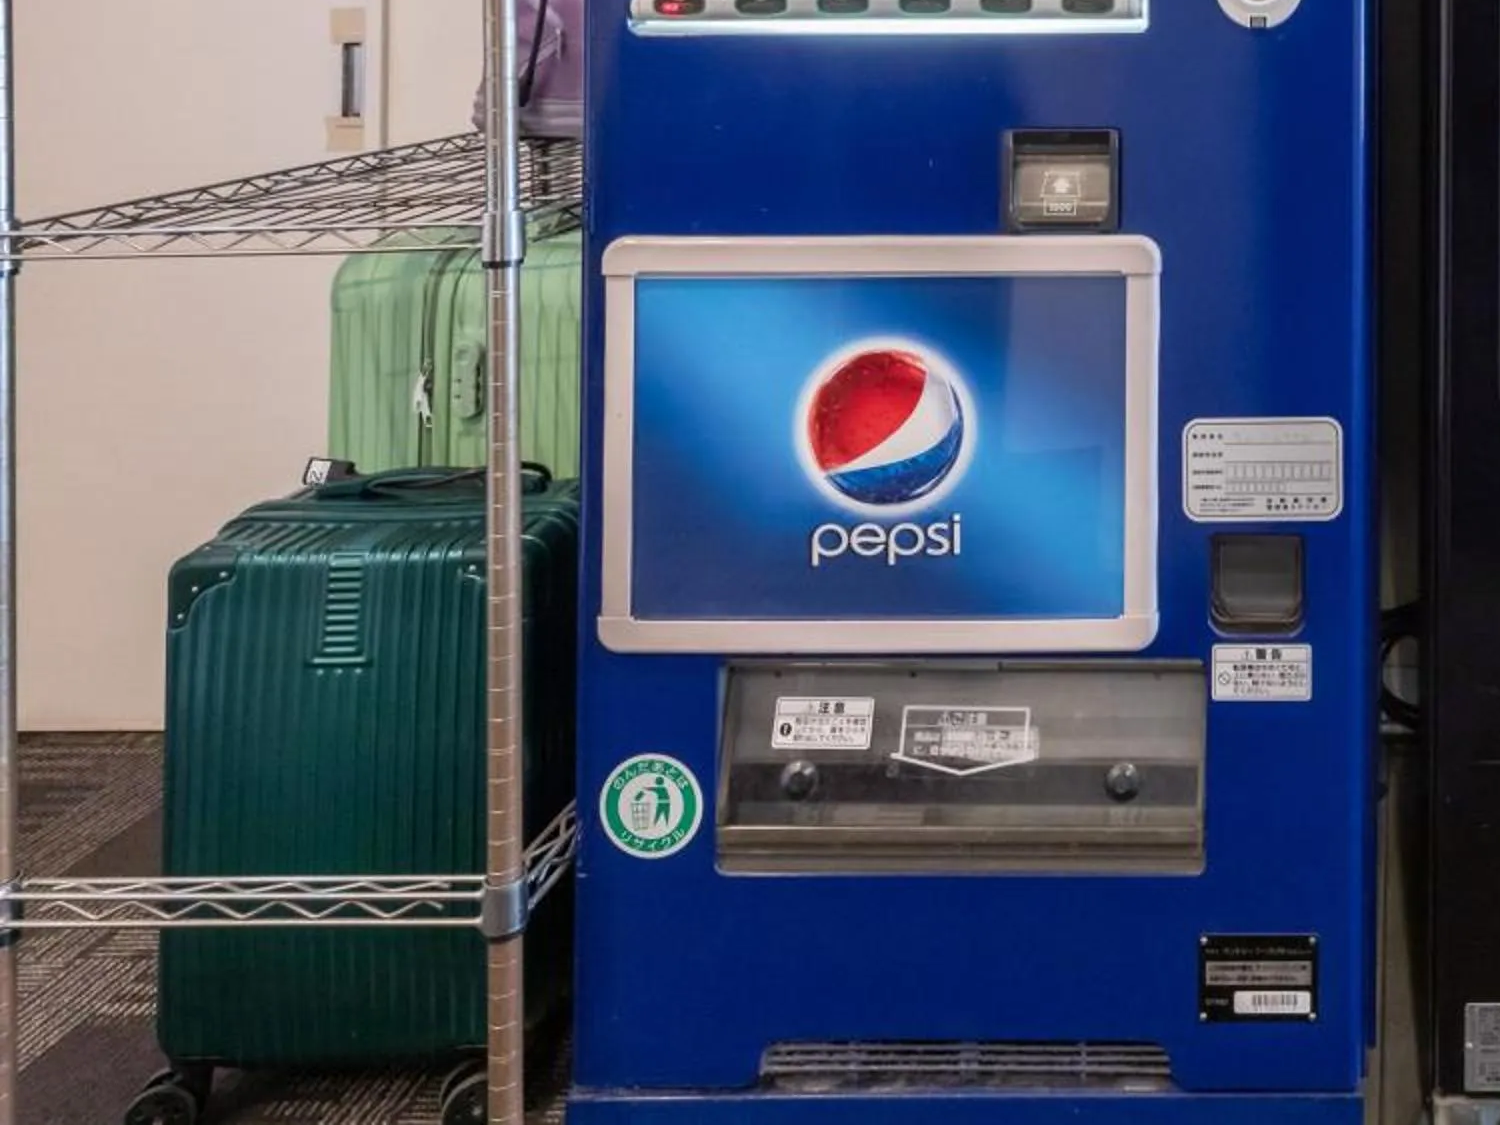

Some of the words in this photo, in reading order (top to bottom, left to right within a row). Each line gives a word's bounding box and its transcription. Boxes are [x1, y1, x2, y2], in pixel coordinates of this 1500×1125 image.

[811, 513, 961, 566] pepsi
[620, 828, 686, 851] リサイクル
